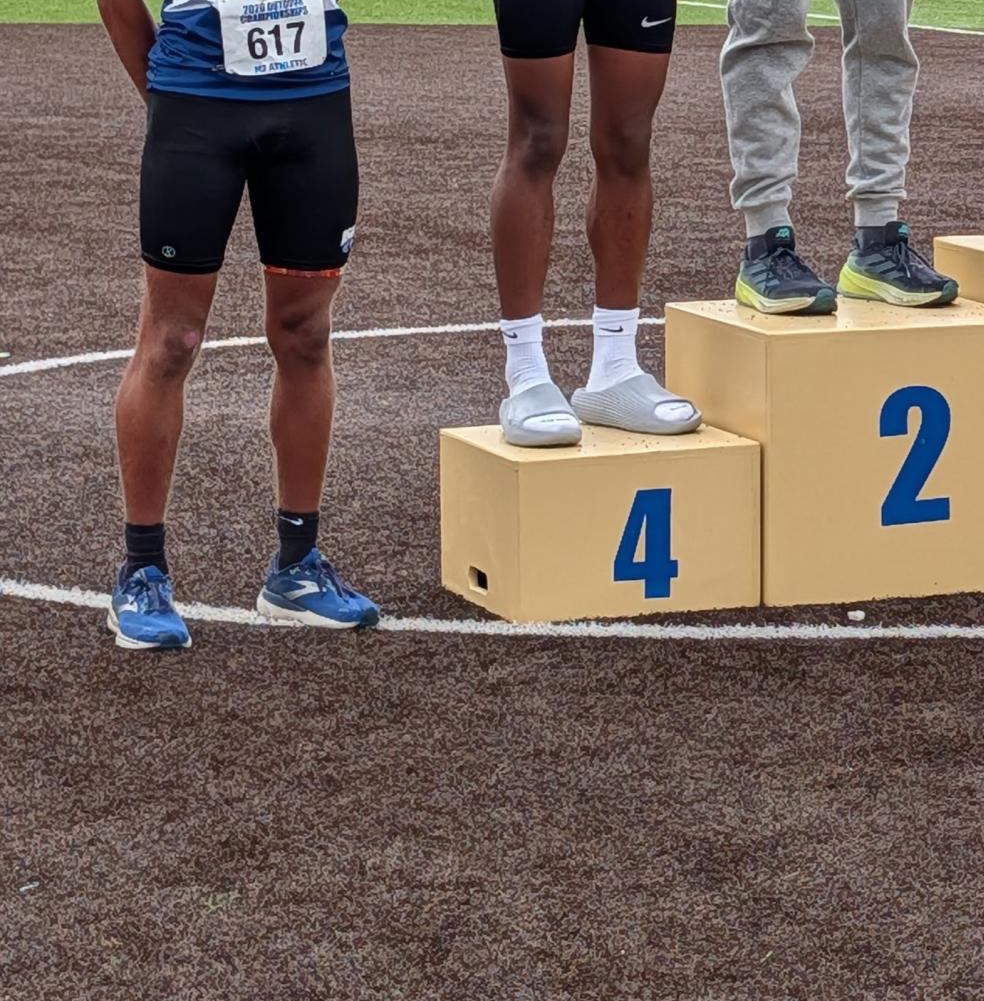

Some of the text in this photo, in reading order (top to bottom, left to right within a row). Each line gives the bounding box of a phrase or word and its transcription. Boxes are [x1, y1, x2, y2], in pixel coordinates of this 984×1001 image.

[247, 21, 305, 60] 617
[879, 385, 951, 527] 2
[613, 488, 679, 599] 4
